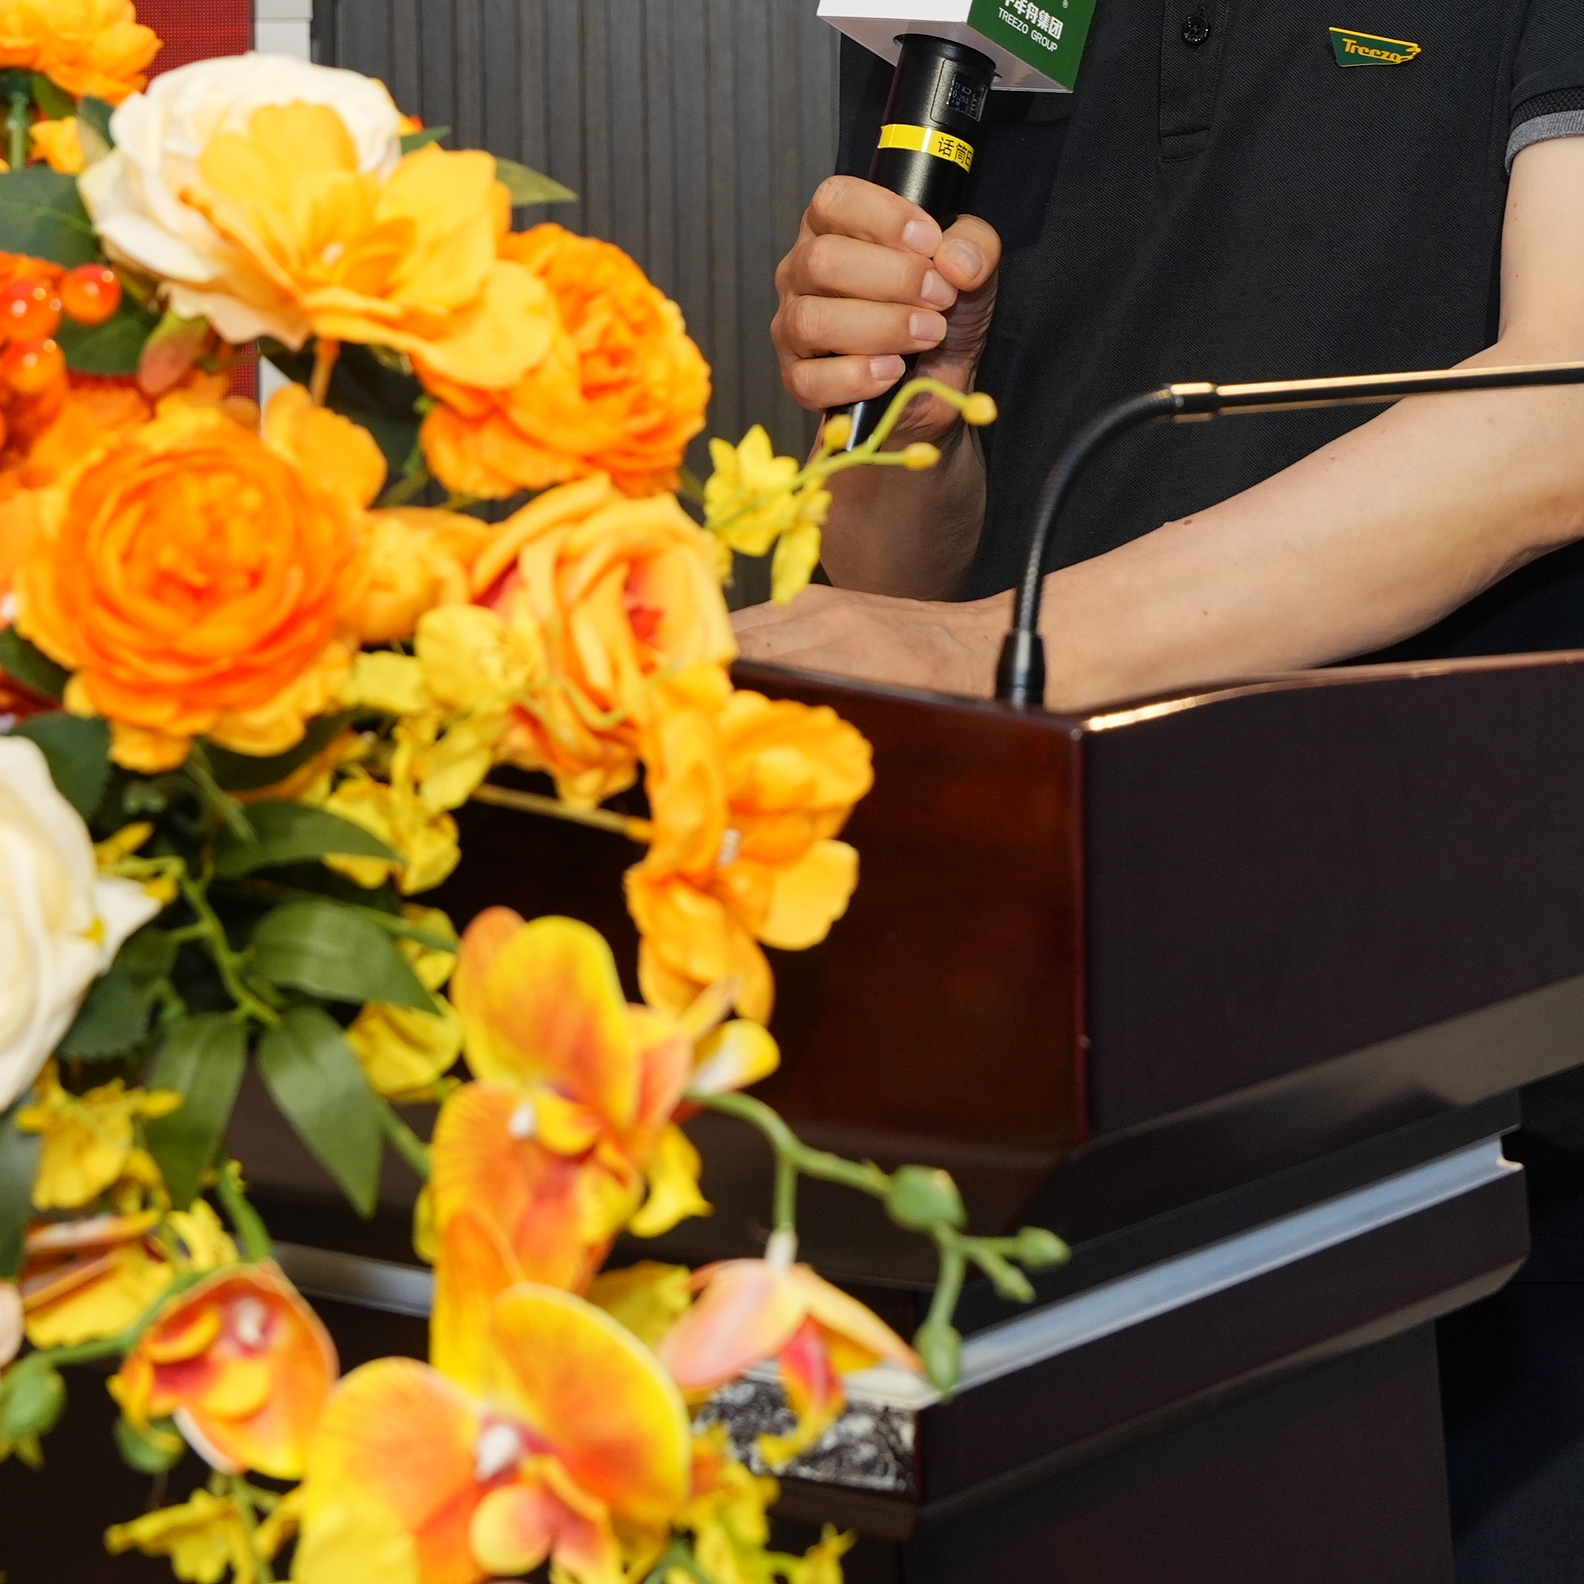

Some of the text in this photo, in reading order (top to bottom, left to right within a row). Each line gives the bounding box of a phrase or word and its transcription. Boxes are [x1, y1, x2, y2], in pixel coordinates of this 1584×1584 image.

[998, 6, 1058, 52] TREEZO GROUP
[1342, 38, 1401, 64] Treezo
